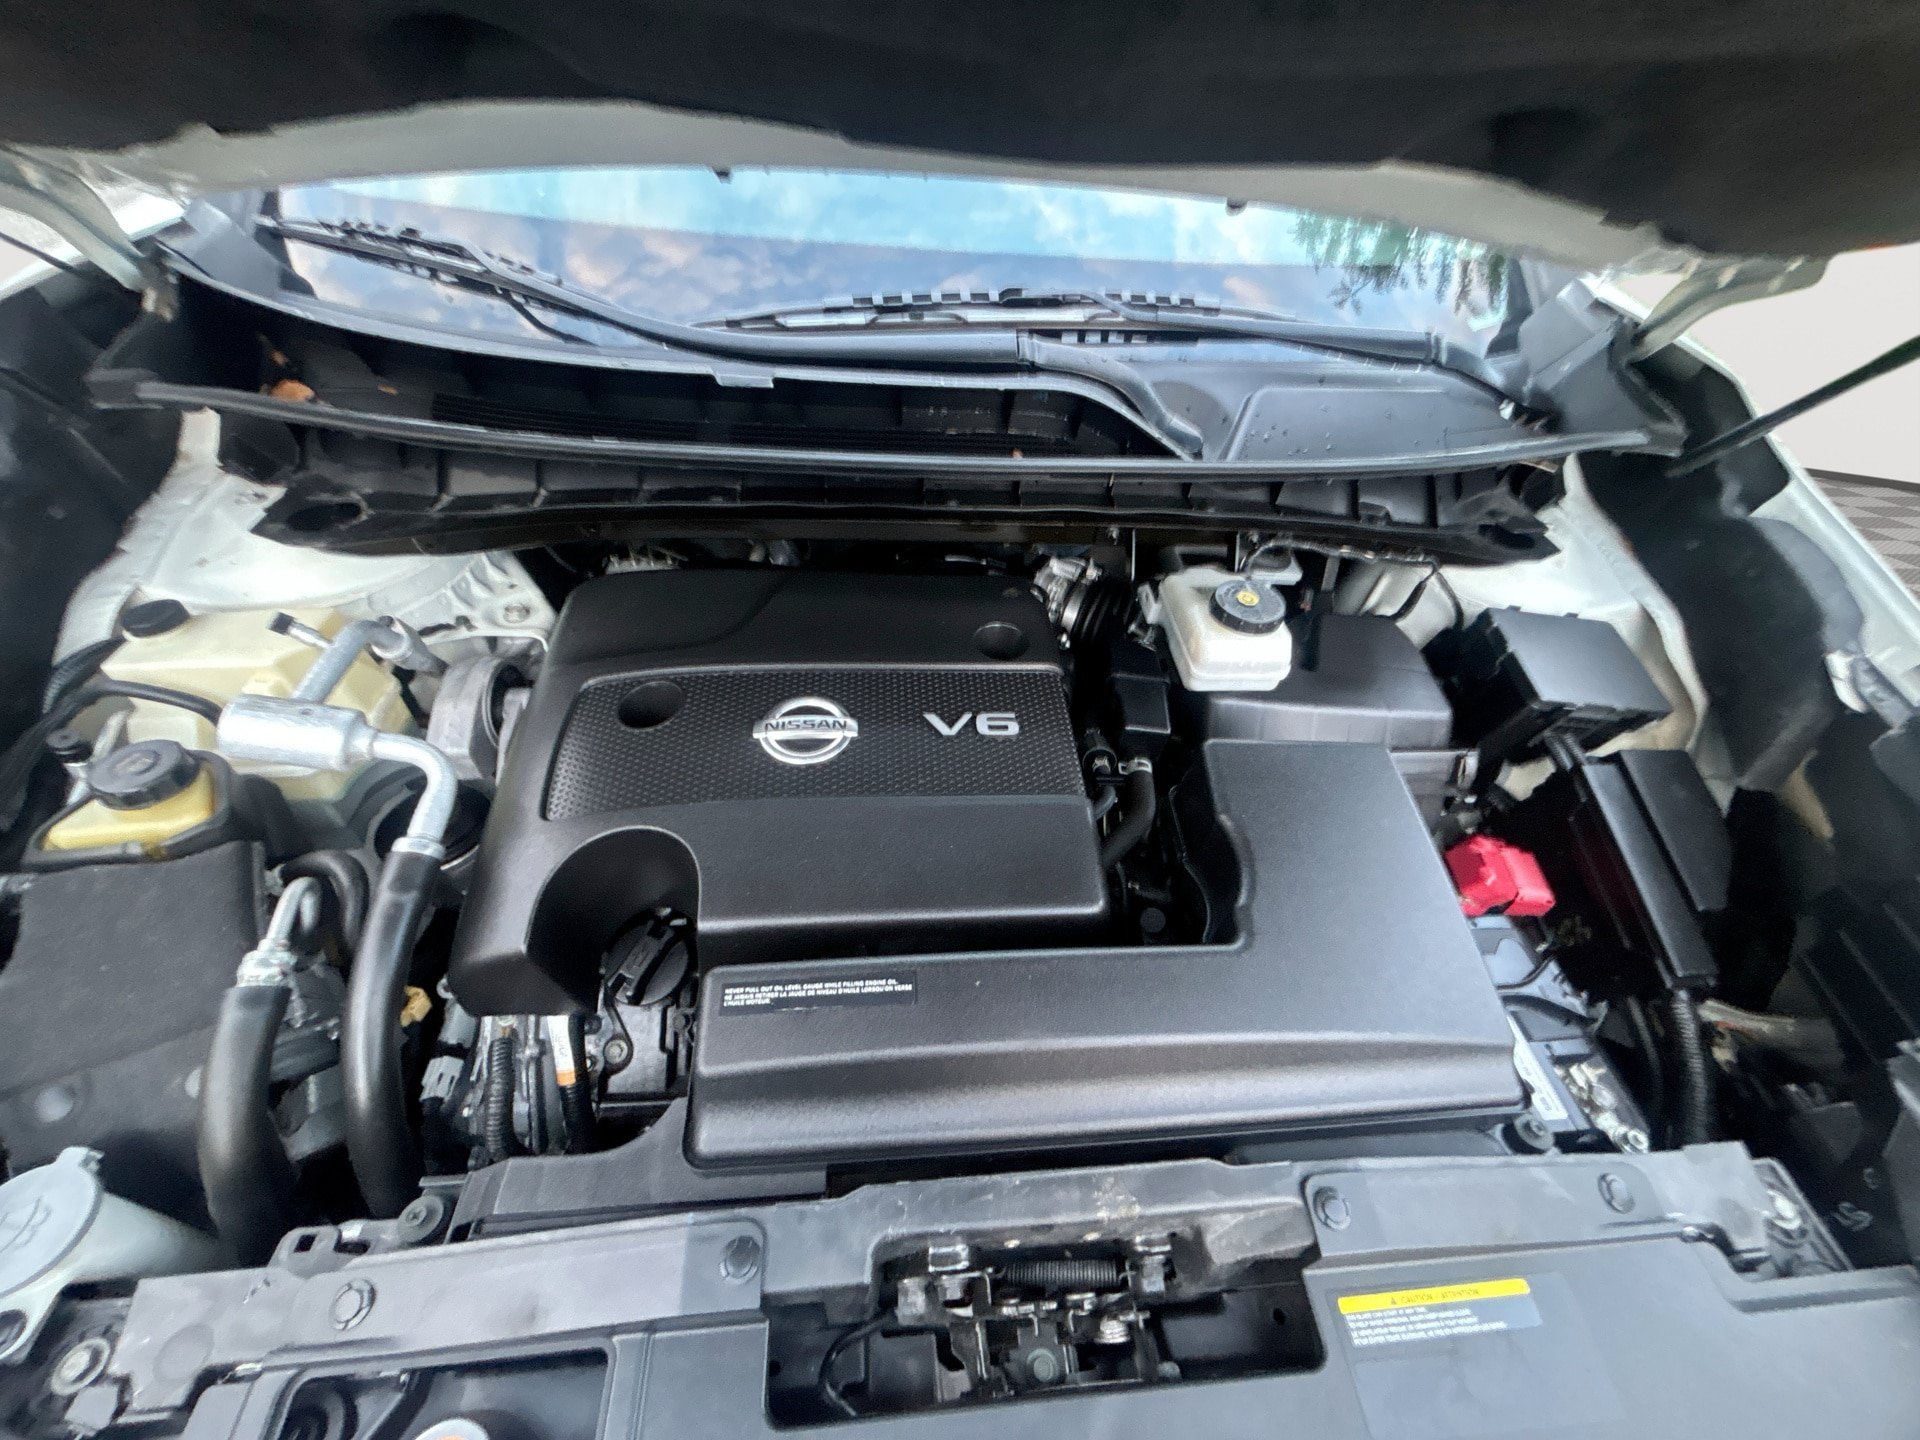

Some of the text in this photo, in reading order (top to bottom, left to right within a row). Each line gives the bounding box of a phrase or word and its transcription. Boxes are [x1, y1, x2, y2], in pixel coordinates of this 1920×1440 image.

[764, 717, 848, 731] NISSAN
[922, 711, 1020, 736] V6
[760, 985, 773, 993] OUT
[1401, 1294, 1433, 1304] CAUTION
